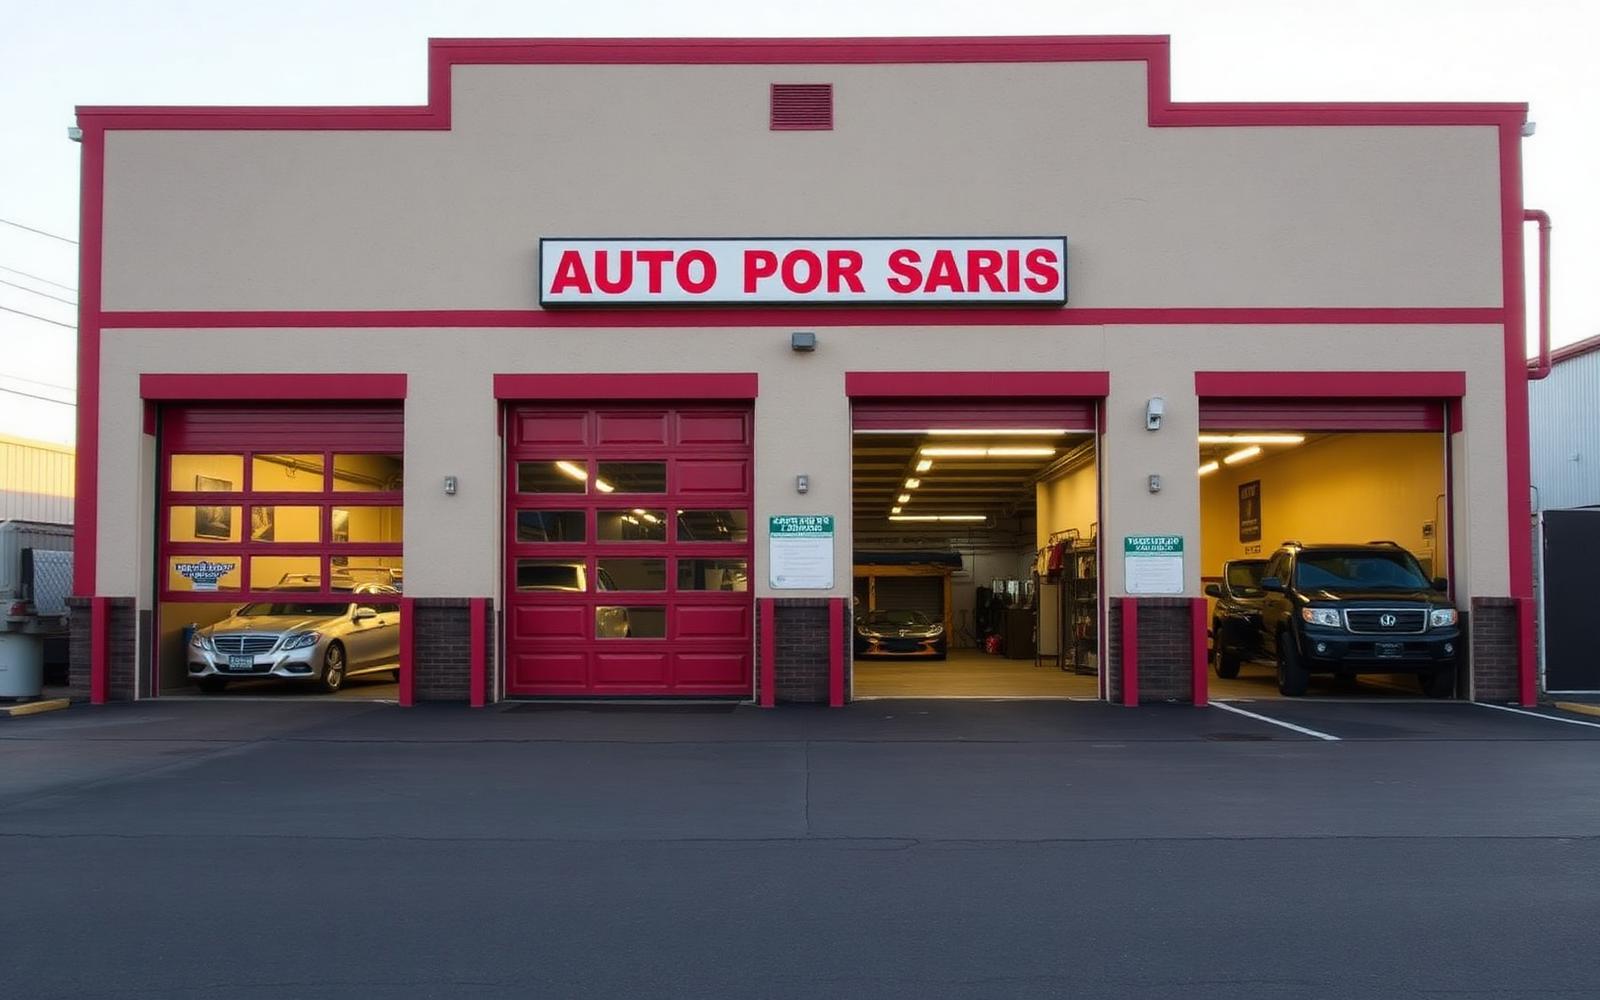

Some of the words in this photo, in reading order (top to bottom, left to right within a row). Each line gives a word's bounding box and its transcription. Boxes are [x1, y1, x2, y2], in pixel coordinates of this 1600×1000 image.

[551, 249, 717, 295] AUTO
[743, 249, 864, 295] POR
[887, 248, 1060, 295] SARIS
